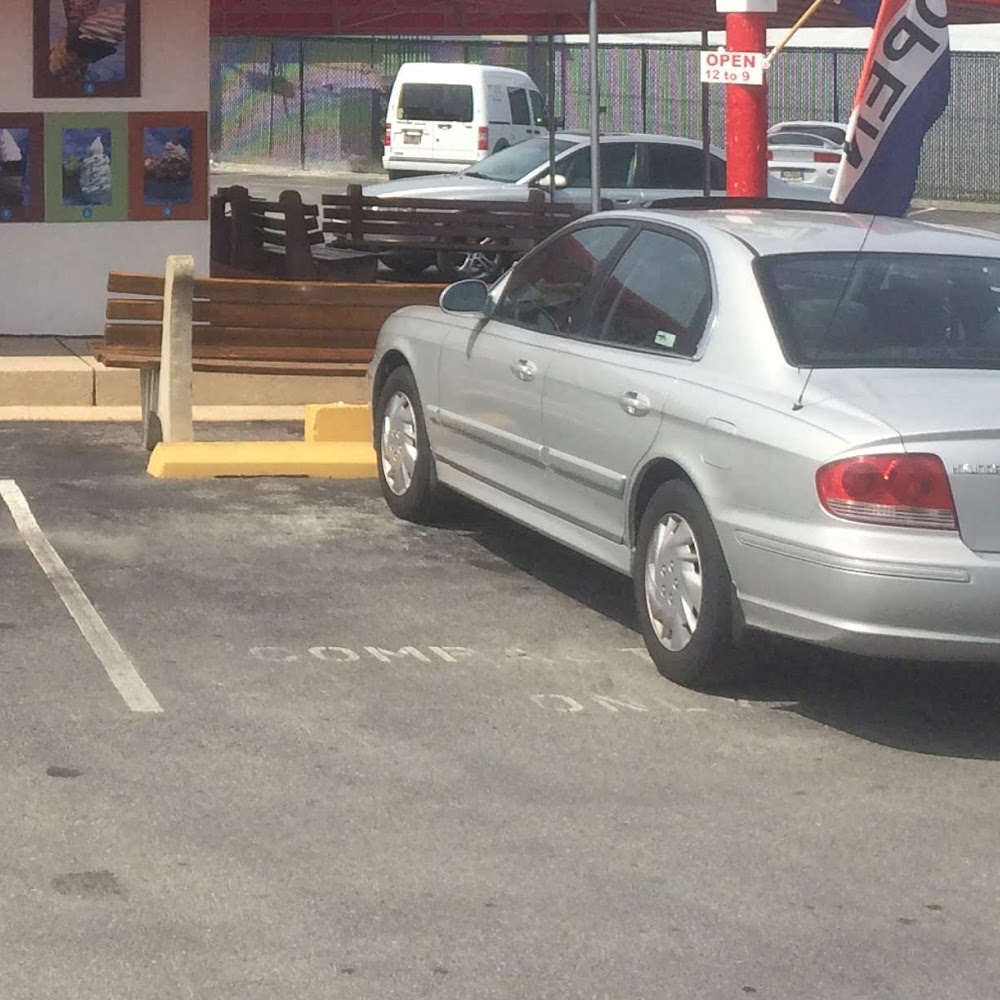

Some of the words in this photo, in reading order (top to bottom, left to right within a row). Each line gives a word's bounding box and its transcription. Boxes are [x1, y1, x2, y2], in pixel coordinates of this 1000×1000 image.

[706, 54, 756, 68] OPEN
[706, 70, 720, 80] 12
[724, 71, 738, 81] to
[742, 71, 750, 81] 9
